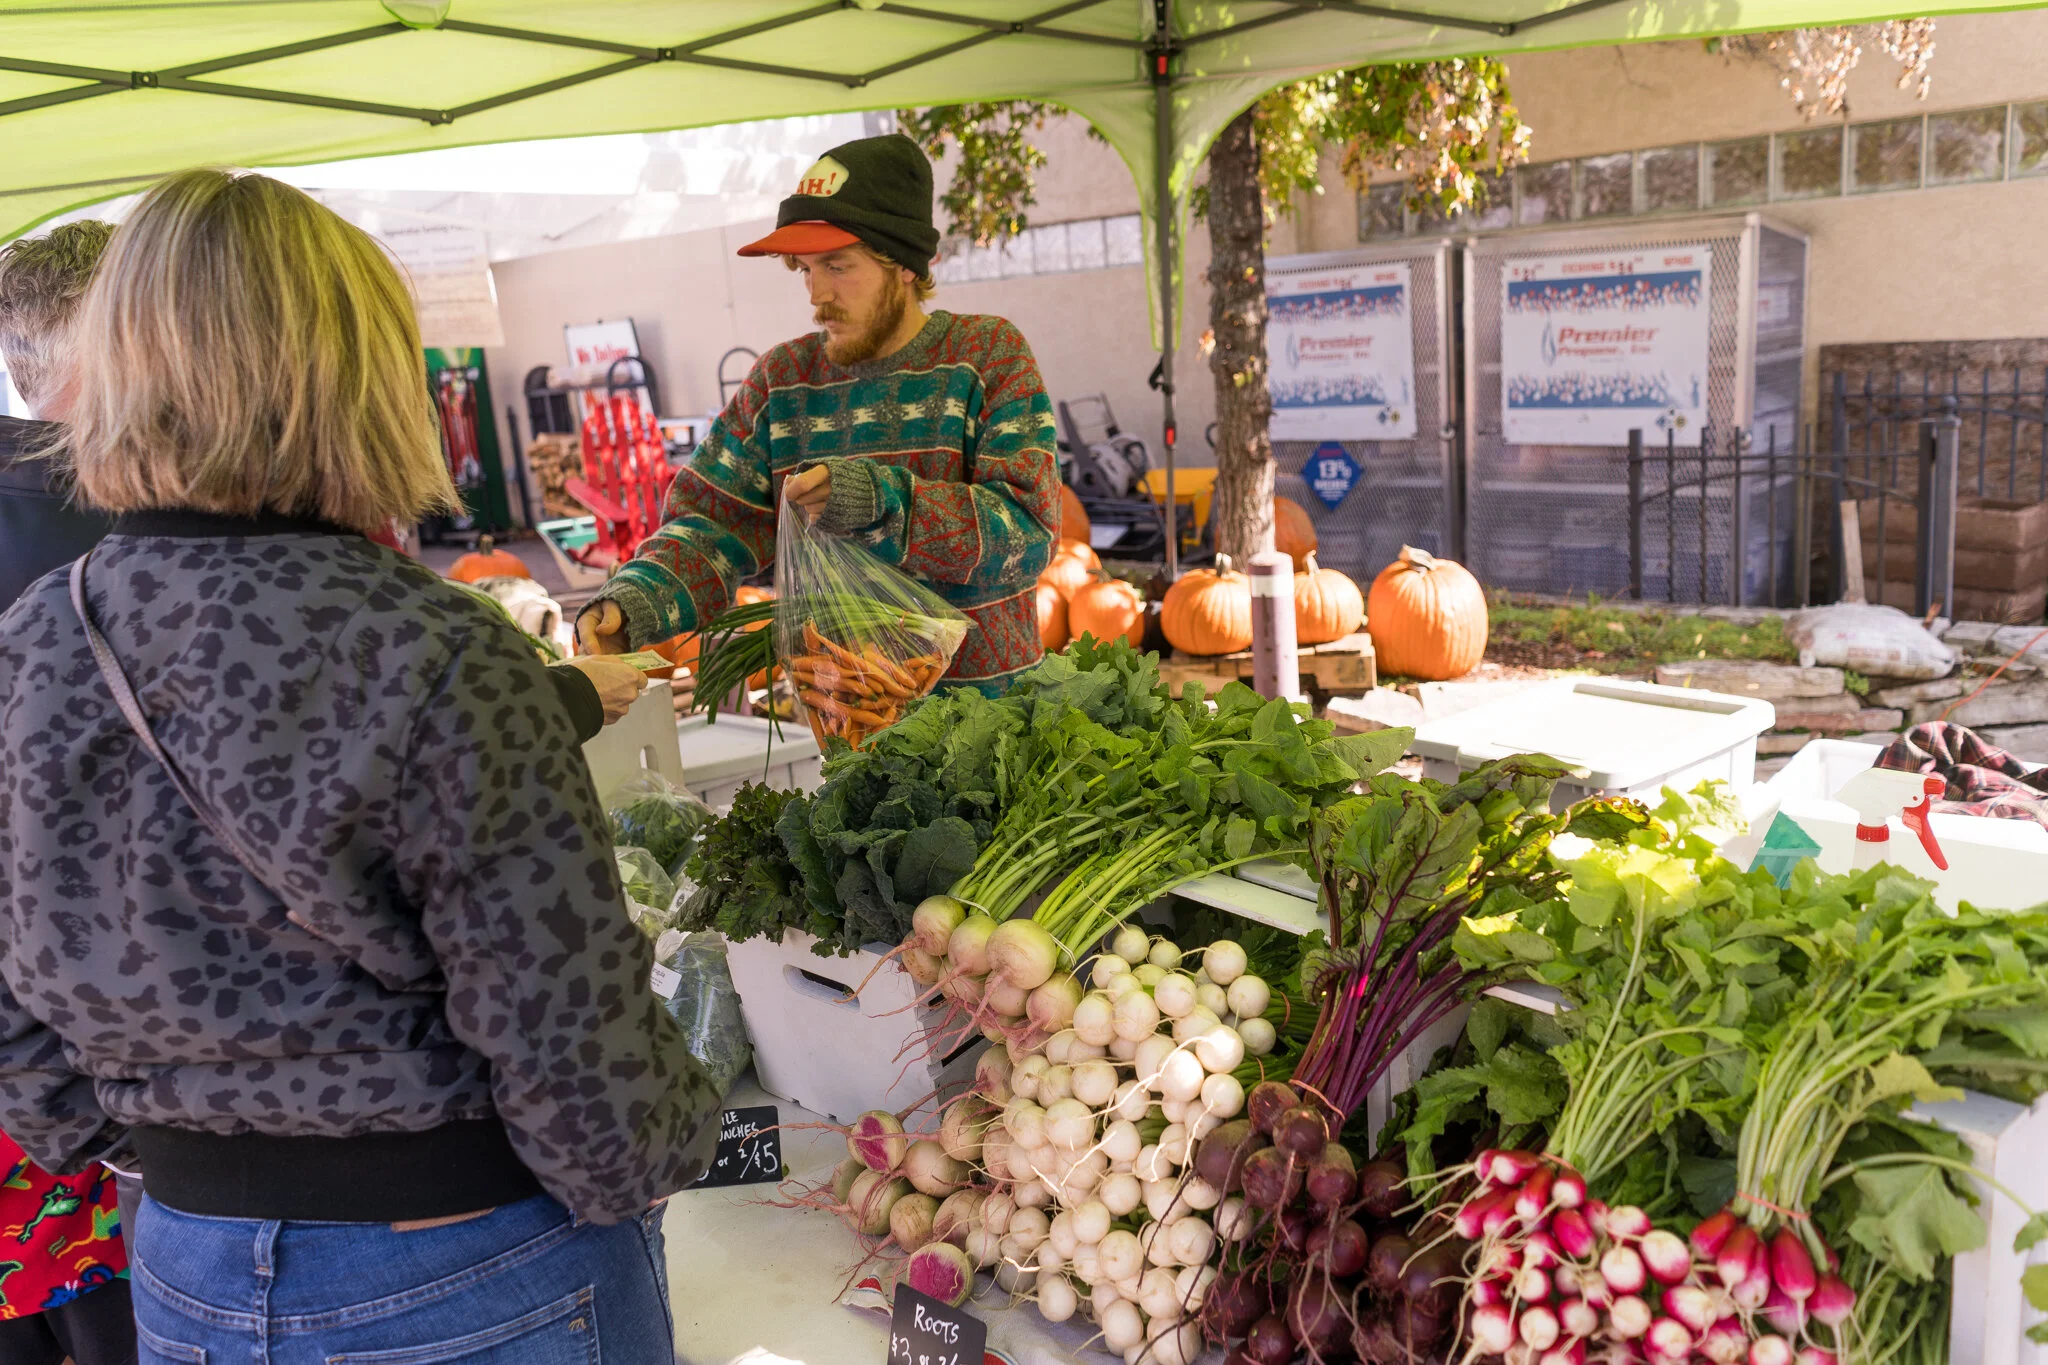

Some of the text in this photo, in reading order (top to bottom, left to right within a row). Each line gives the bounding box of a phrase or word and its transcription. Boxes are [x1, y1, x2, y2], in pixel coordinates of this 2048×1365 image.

[1299, 332, 1375, 351] Premier
[1559, 324, 1660, 343] Premier
[719, 1122, 759, 1142] UNCHES
[914, 1303, 960, 1345] ROOTS
